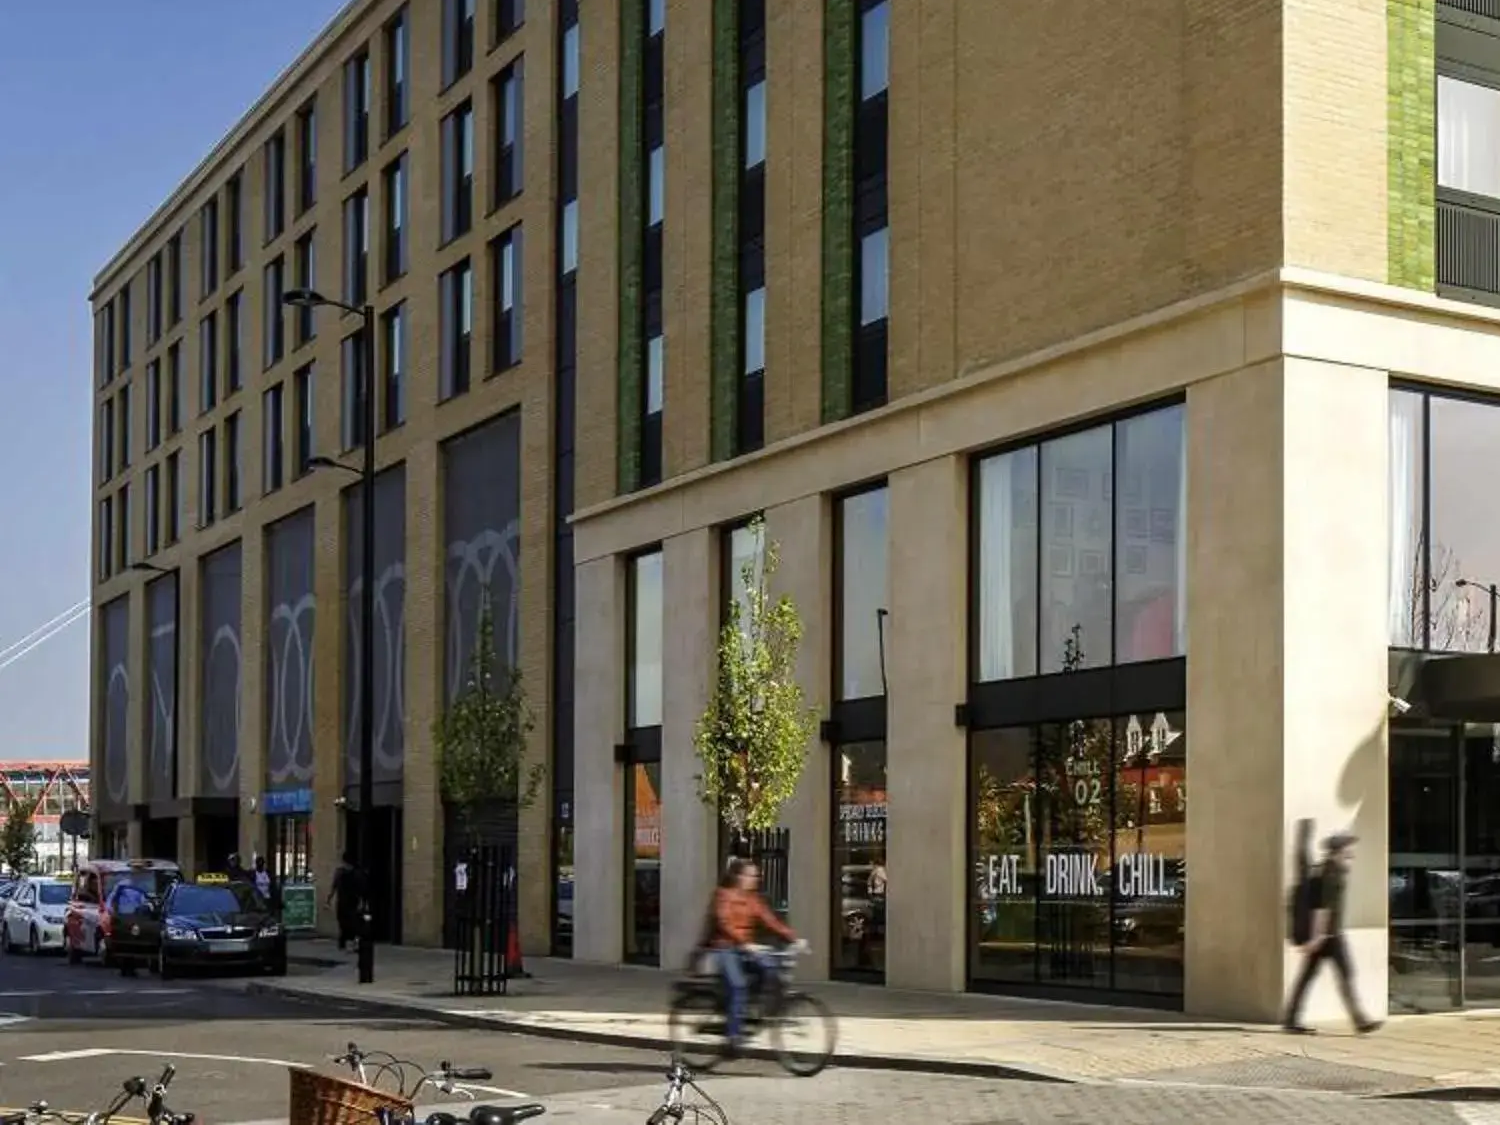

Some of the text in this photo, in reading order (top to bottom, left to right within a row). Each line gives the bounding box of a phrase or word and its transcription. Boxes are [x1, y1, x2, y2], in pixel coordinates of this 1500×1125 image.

[1074, 780, 1101, 805] 02
[845, 822, 884, 843] DRINKS
[989, 854, 1175, 896] EAT. DRINK. CHILL.
